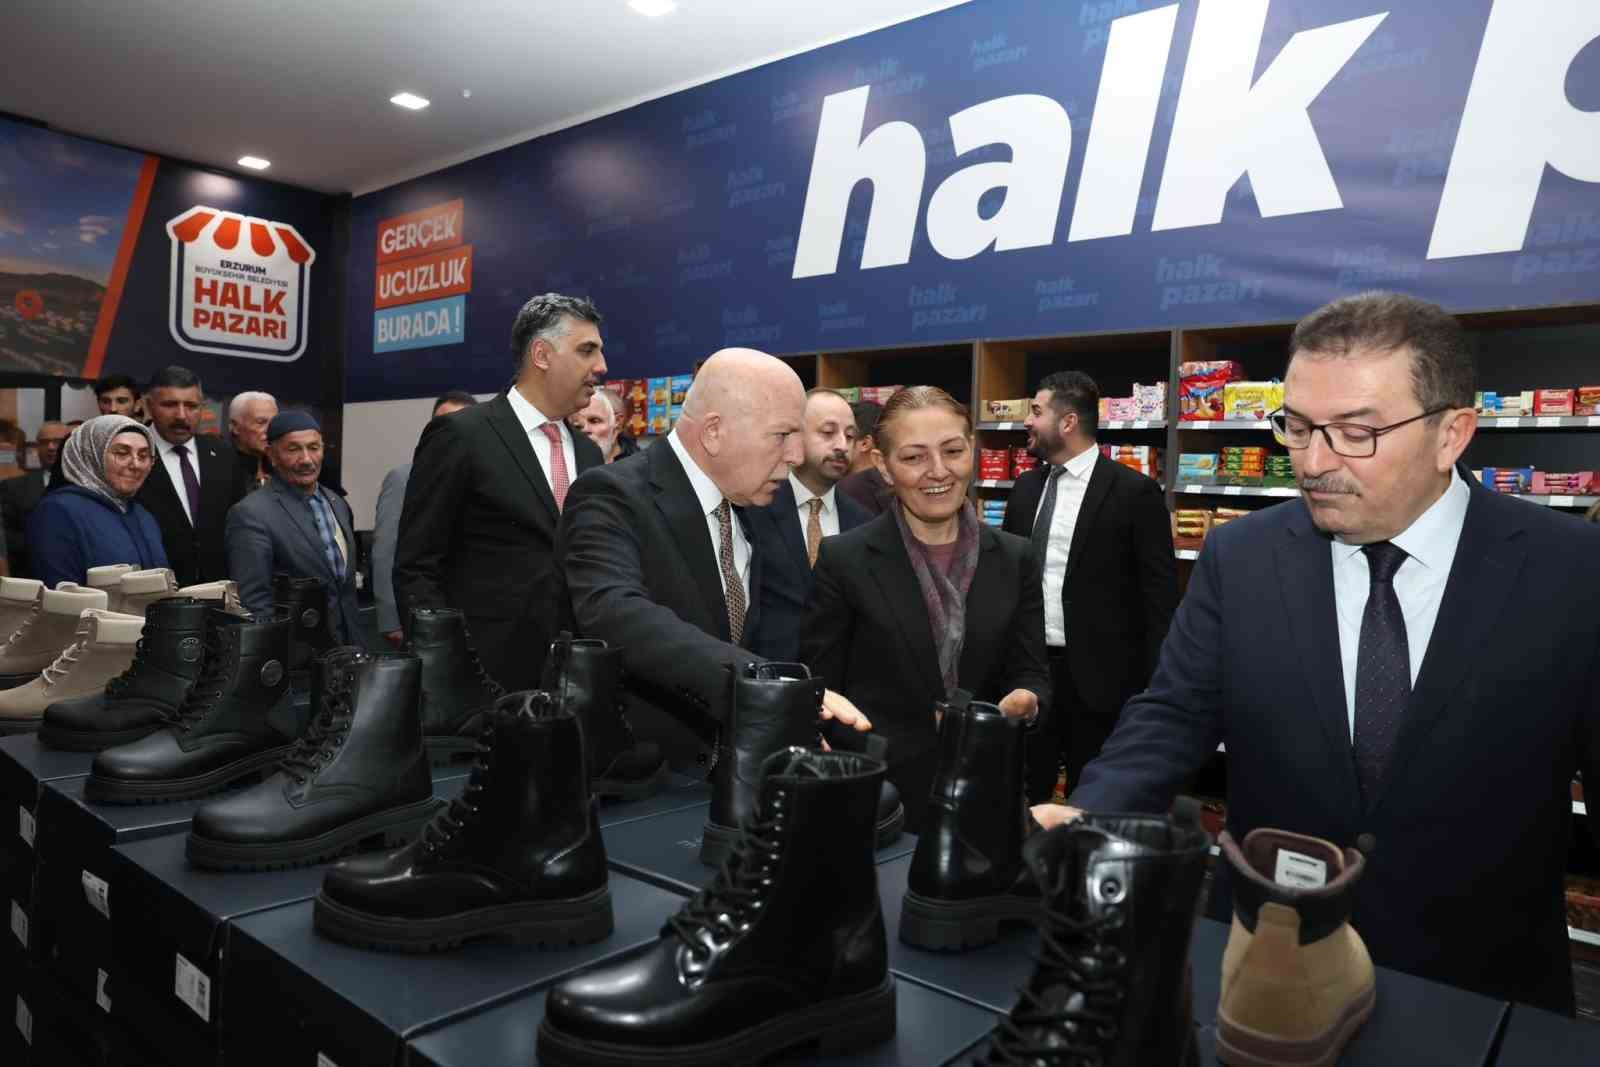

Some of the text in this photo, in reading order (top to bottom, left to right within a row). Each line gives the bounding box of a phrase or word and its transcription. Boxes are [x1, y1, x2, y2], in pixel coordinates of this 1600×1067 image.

[792, 0, 1390, 280] halk
[381, 212, 457, 254] GERÇEK
[220, 260, 266, 275] ERZURUM
[379, 256, 467, 299] UCUZLUK
[194, 277, 287, 316] HALK
[193, 308, 287, 339] PAZARI
[378, 307, 449, 343] BURADA
